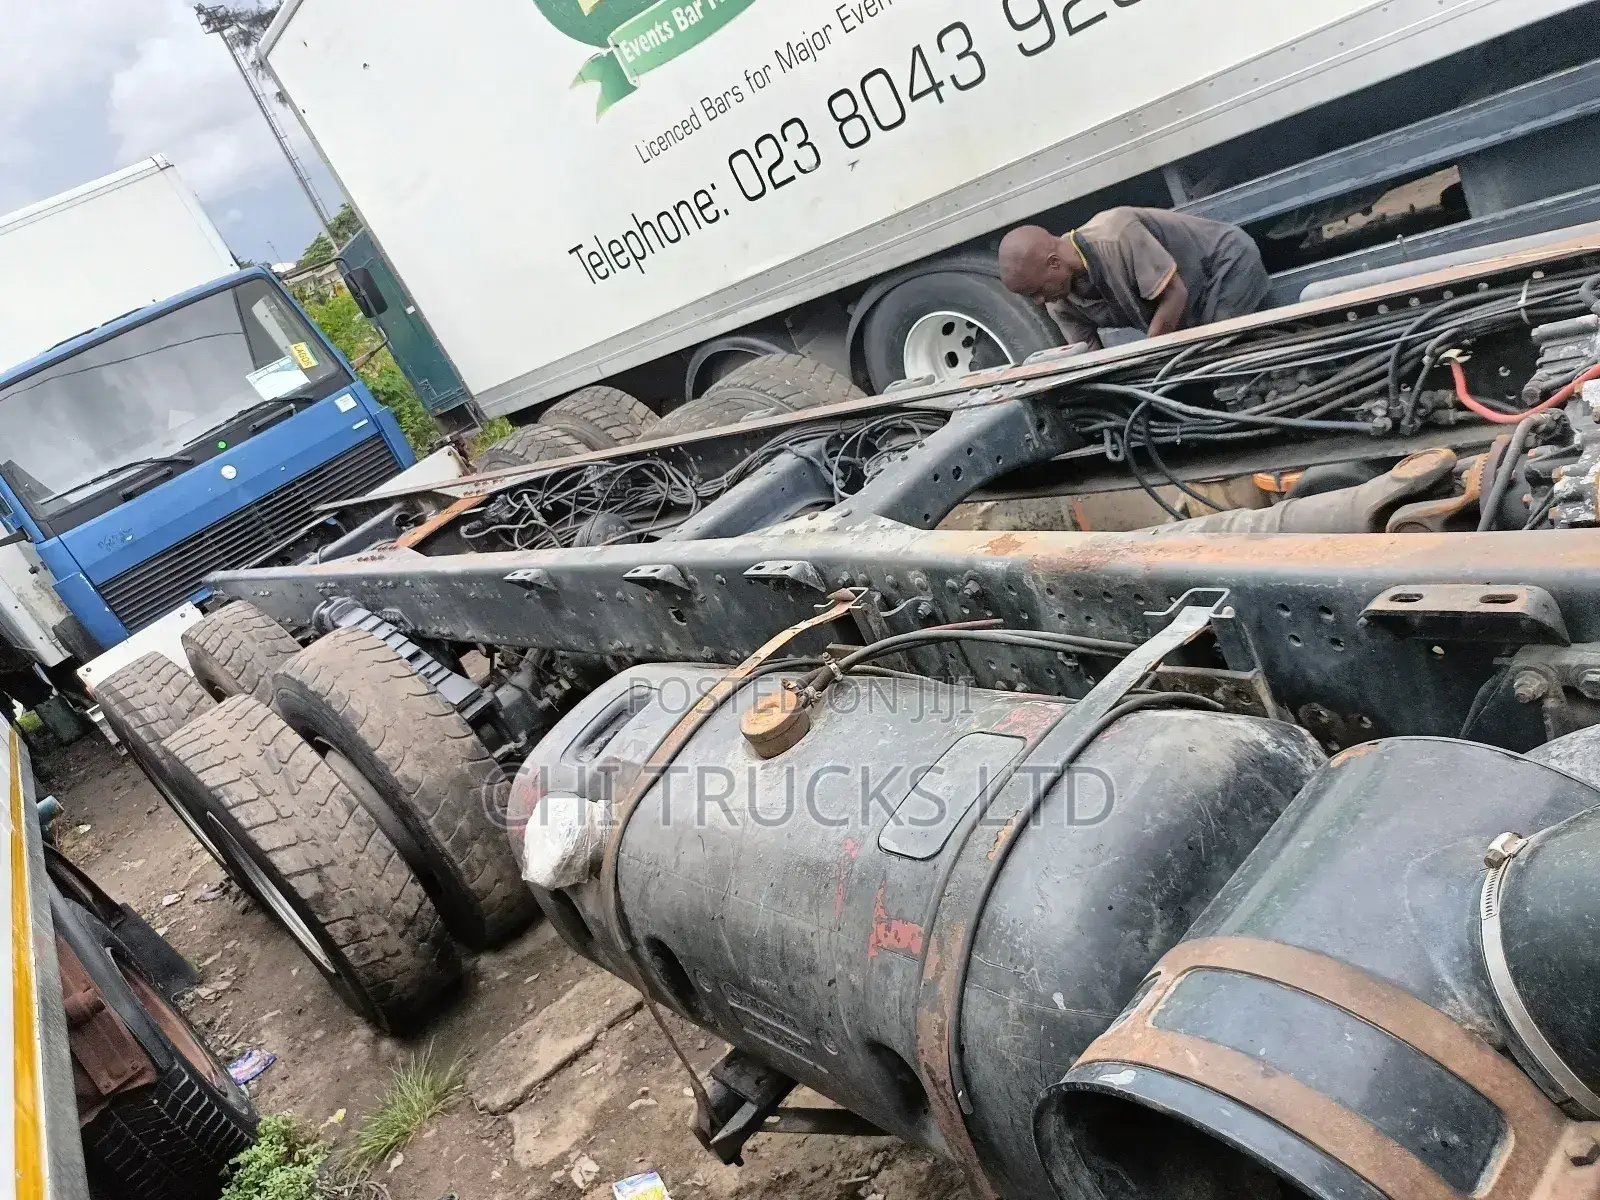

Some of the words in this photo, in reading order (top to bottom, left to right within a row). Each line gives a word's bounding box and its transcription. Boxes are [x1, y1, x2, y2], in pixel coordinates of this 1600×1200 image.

[618, 20, 675, 64] Events
[671, 0, 705, 32] Bar
[567, 182, 730, 286] Telephone:
[727, 117, 822, 202] 023
[826, 20, 987, 150] 8043
[1001, 0, 1144, 58] 92
[634, 106, 702, 164] Licenced
[699, 85, 745, 122] Bars
[743, 63, 772, 94] for
[774, 23, 833, 74] Major
[293, 344, 312, 367] LAGOS
